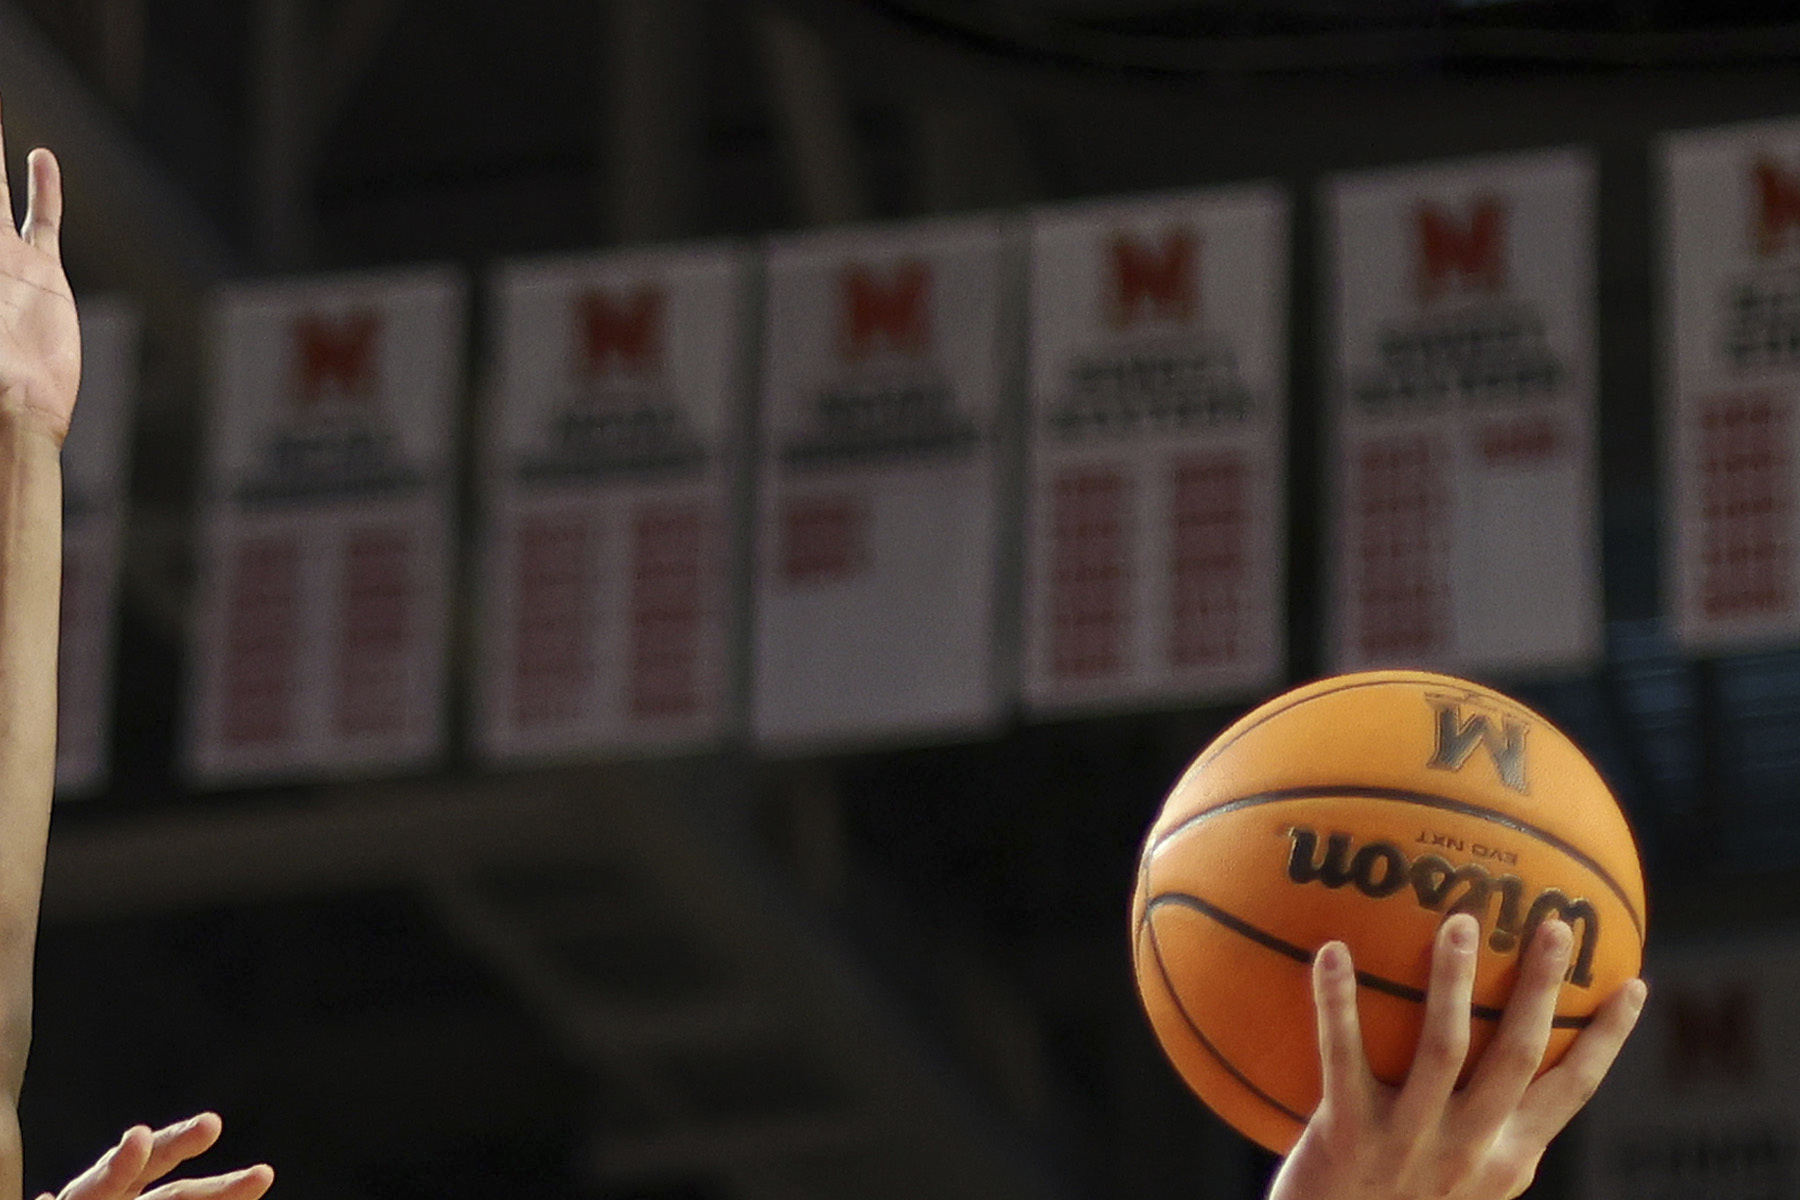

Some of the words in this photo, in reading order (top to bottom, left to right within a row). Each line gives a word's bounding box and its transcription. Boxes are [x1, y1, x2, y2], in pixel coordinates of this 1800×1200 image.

[1424, 692, 1532, 796] M
[1415, 830, 1465, 852] NXT
[1471, 842, 1518, 867] EVO
